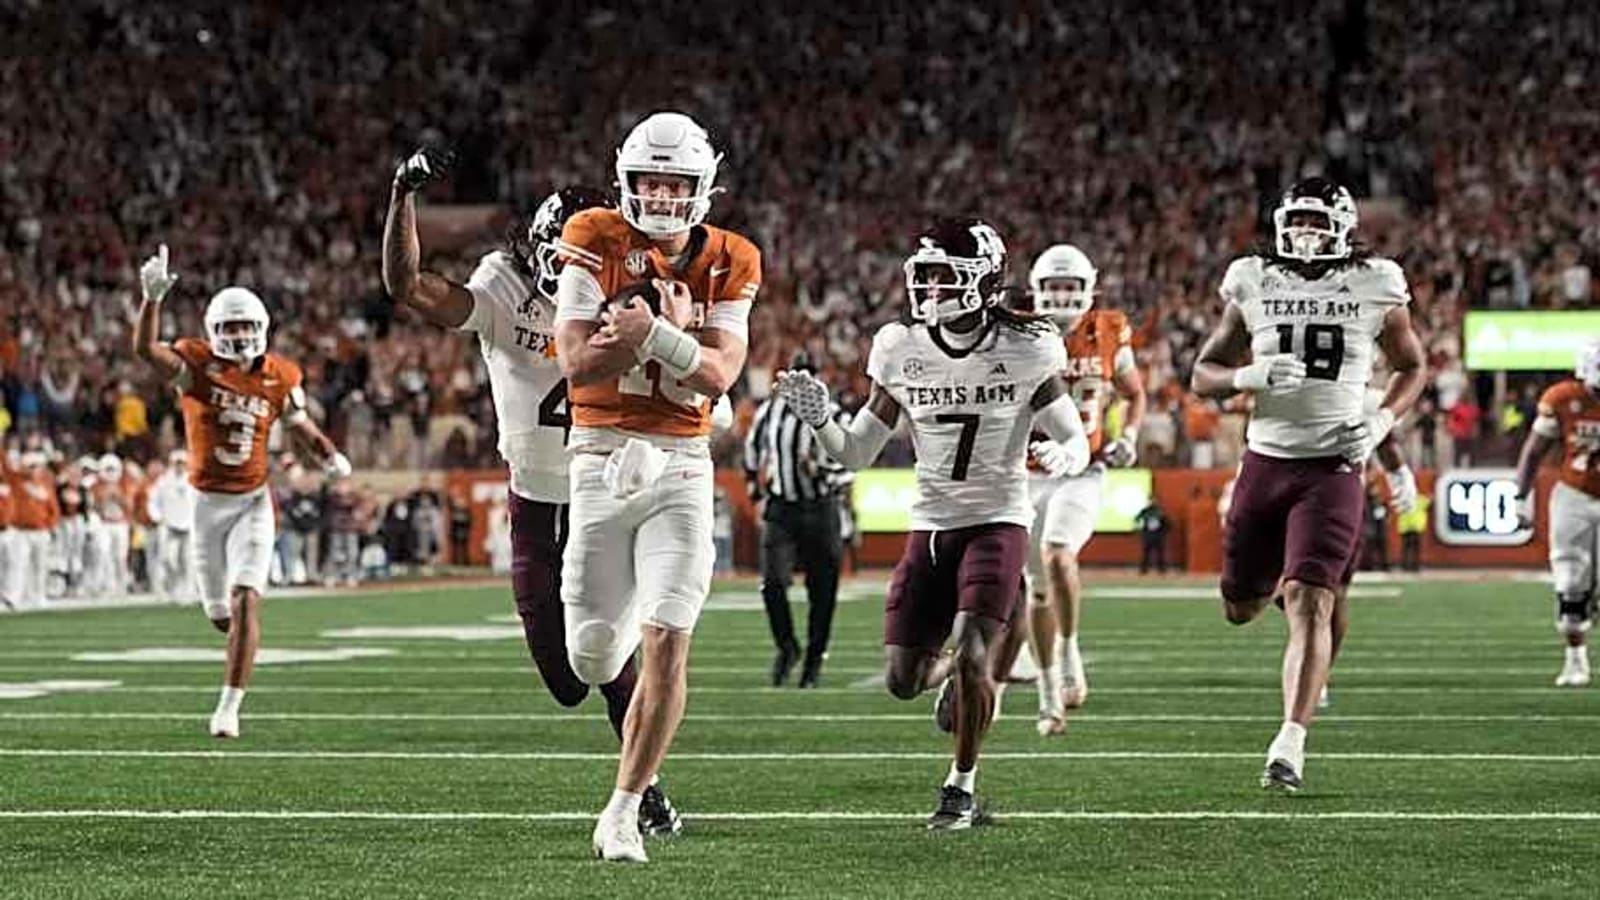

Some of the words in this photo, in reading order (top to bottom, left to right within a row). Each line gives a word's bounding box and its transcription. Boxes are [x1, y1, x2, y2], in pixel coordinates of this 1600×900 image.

[1262, 299, 1319, 316] TEXAS
[514, 325, 557, 354] TEX
[1275, 323, 1345, 382] 18
[1063, 356, 1104, 377] XAS
[210, 386, 271, 417] TEXAS
[537, 376, 573, 447] 4
[905, 385, 967, 405] TEXAS
[214, 409, 257, 466] 3
[935, 413, 984, 481] 7
[1449, 479, 1521, 534] 40
